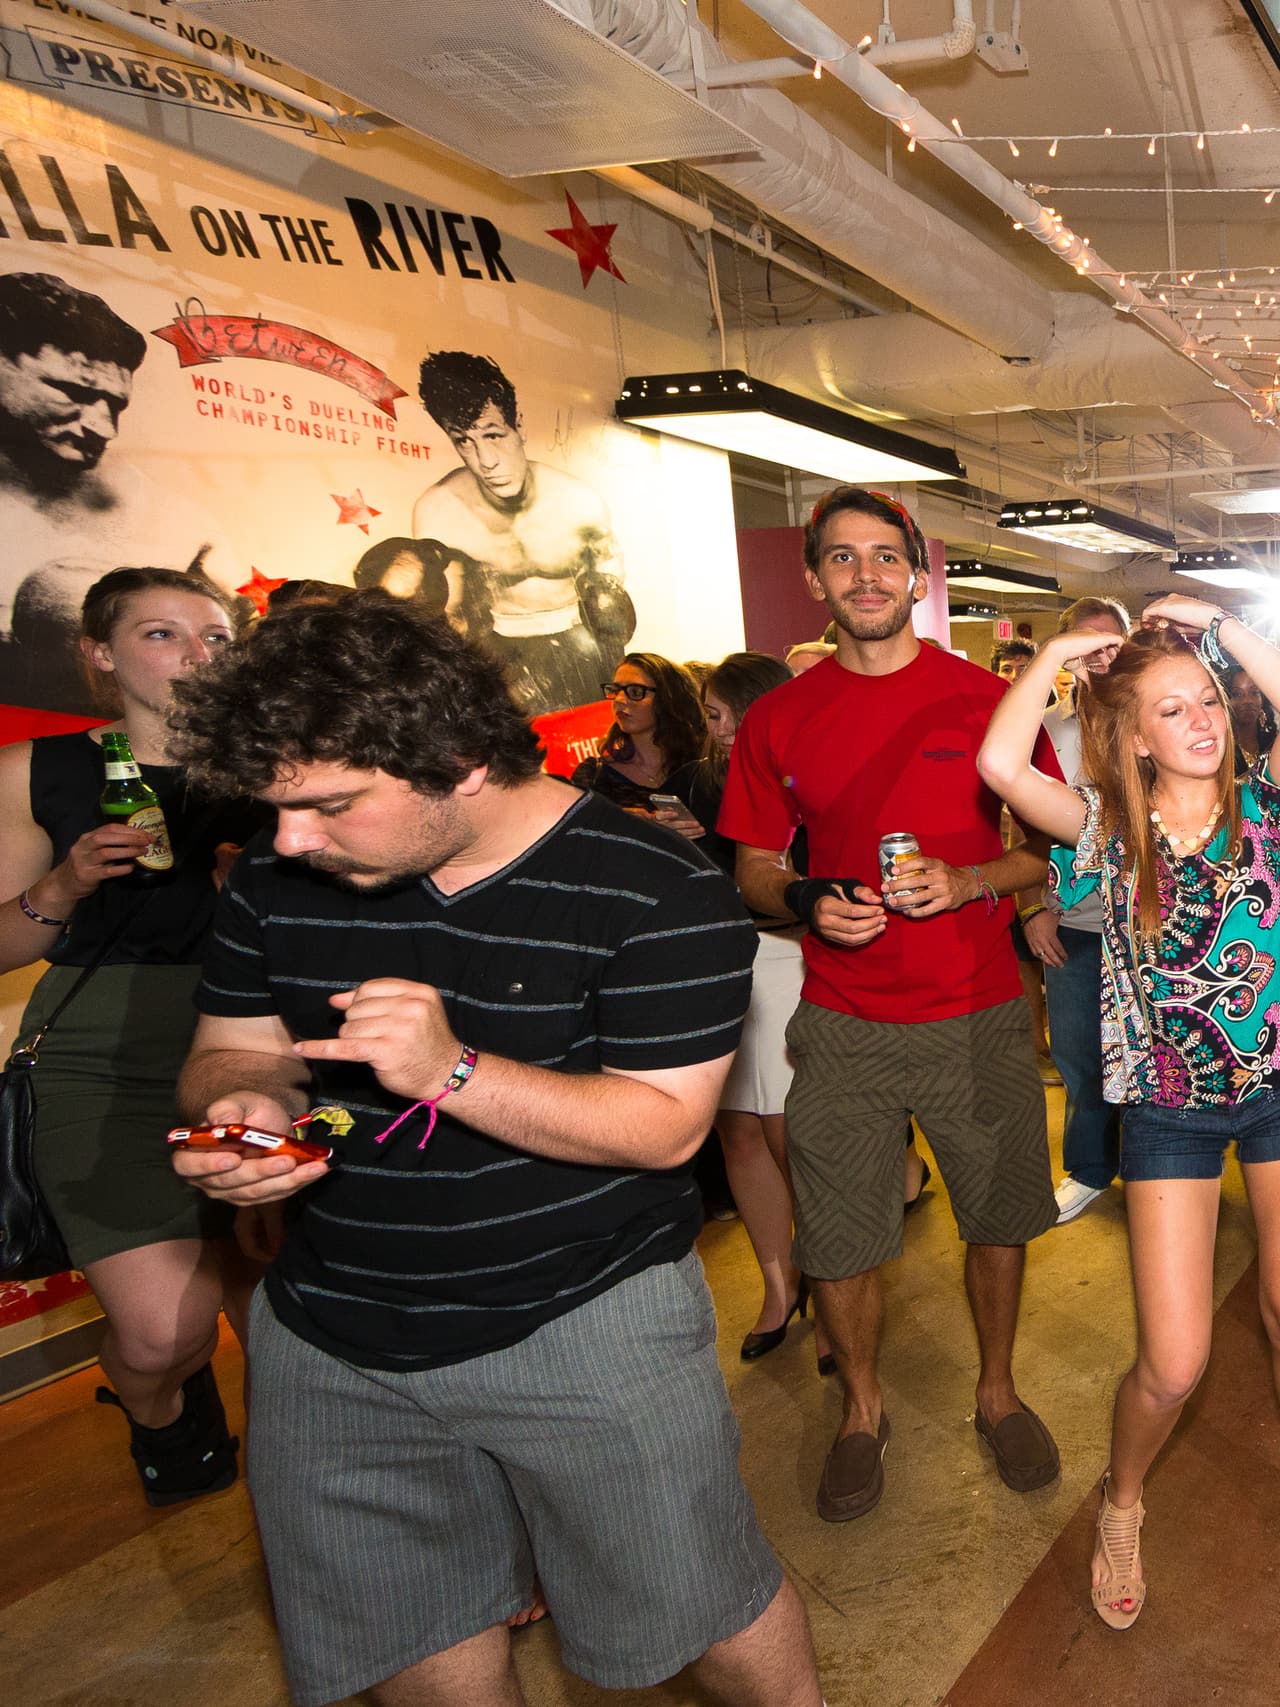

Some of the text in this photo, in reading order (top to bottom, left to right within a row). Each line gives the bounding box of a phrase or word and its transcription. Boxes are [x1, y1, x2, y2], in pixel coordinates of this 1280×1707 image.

[189, 205, 261, 260] ON
[259, 213, 344, 266] THE
[344, 197, 516, 283] RIVER
[191, 374, 396, 433] WORLD'S DUELING
[196, 399, 432, 461] CHAMPIONSHIP FIGHT
[999, 621, 1010, 638] EXIT
